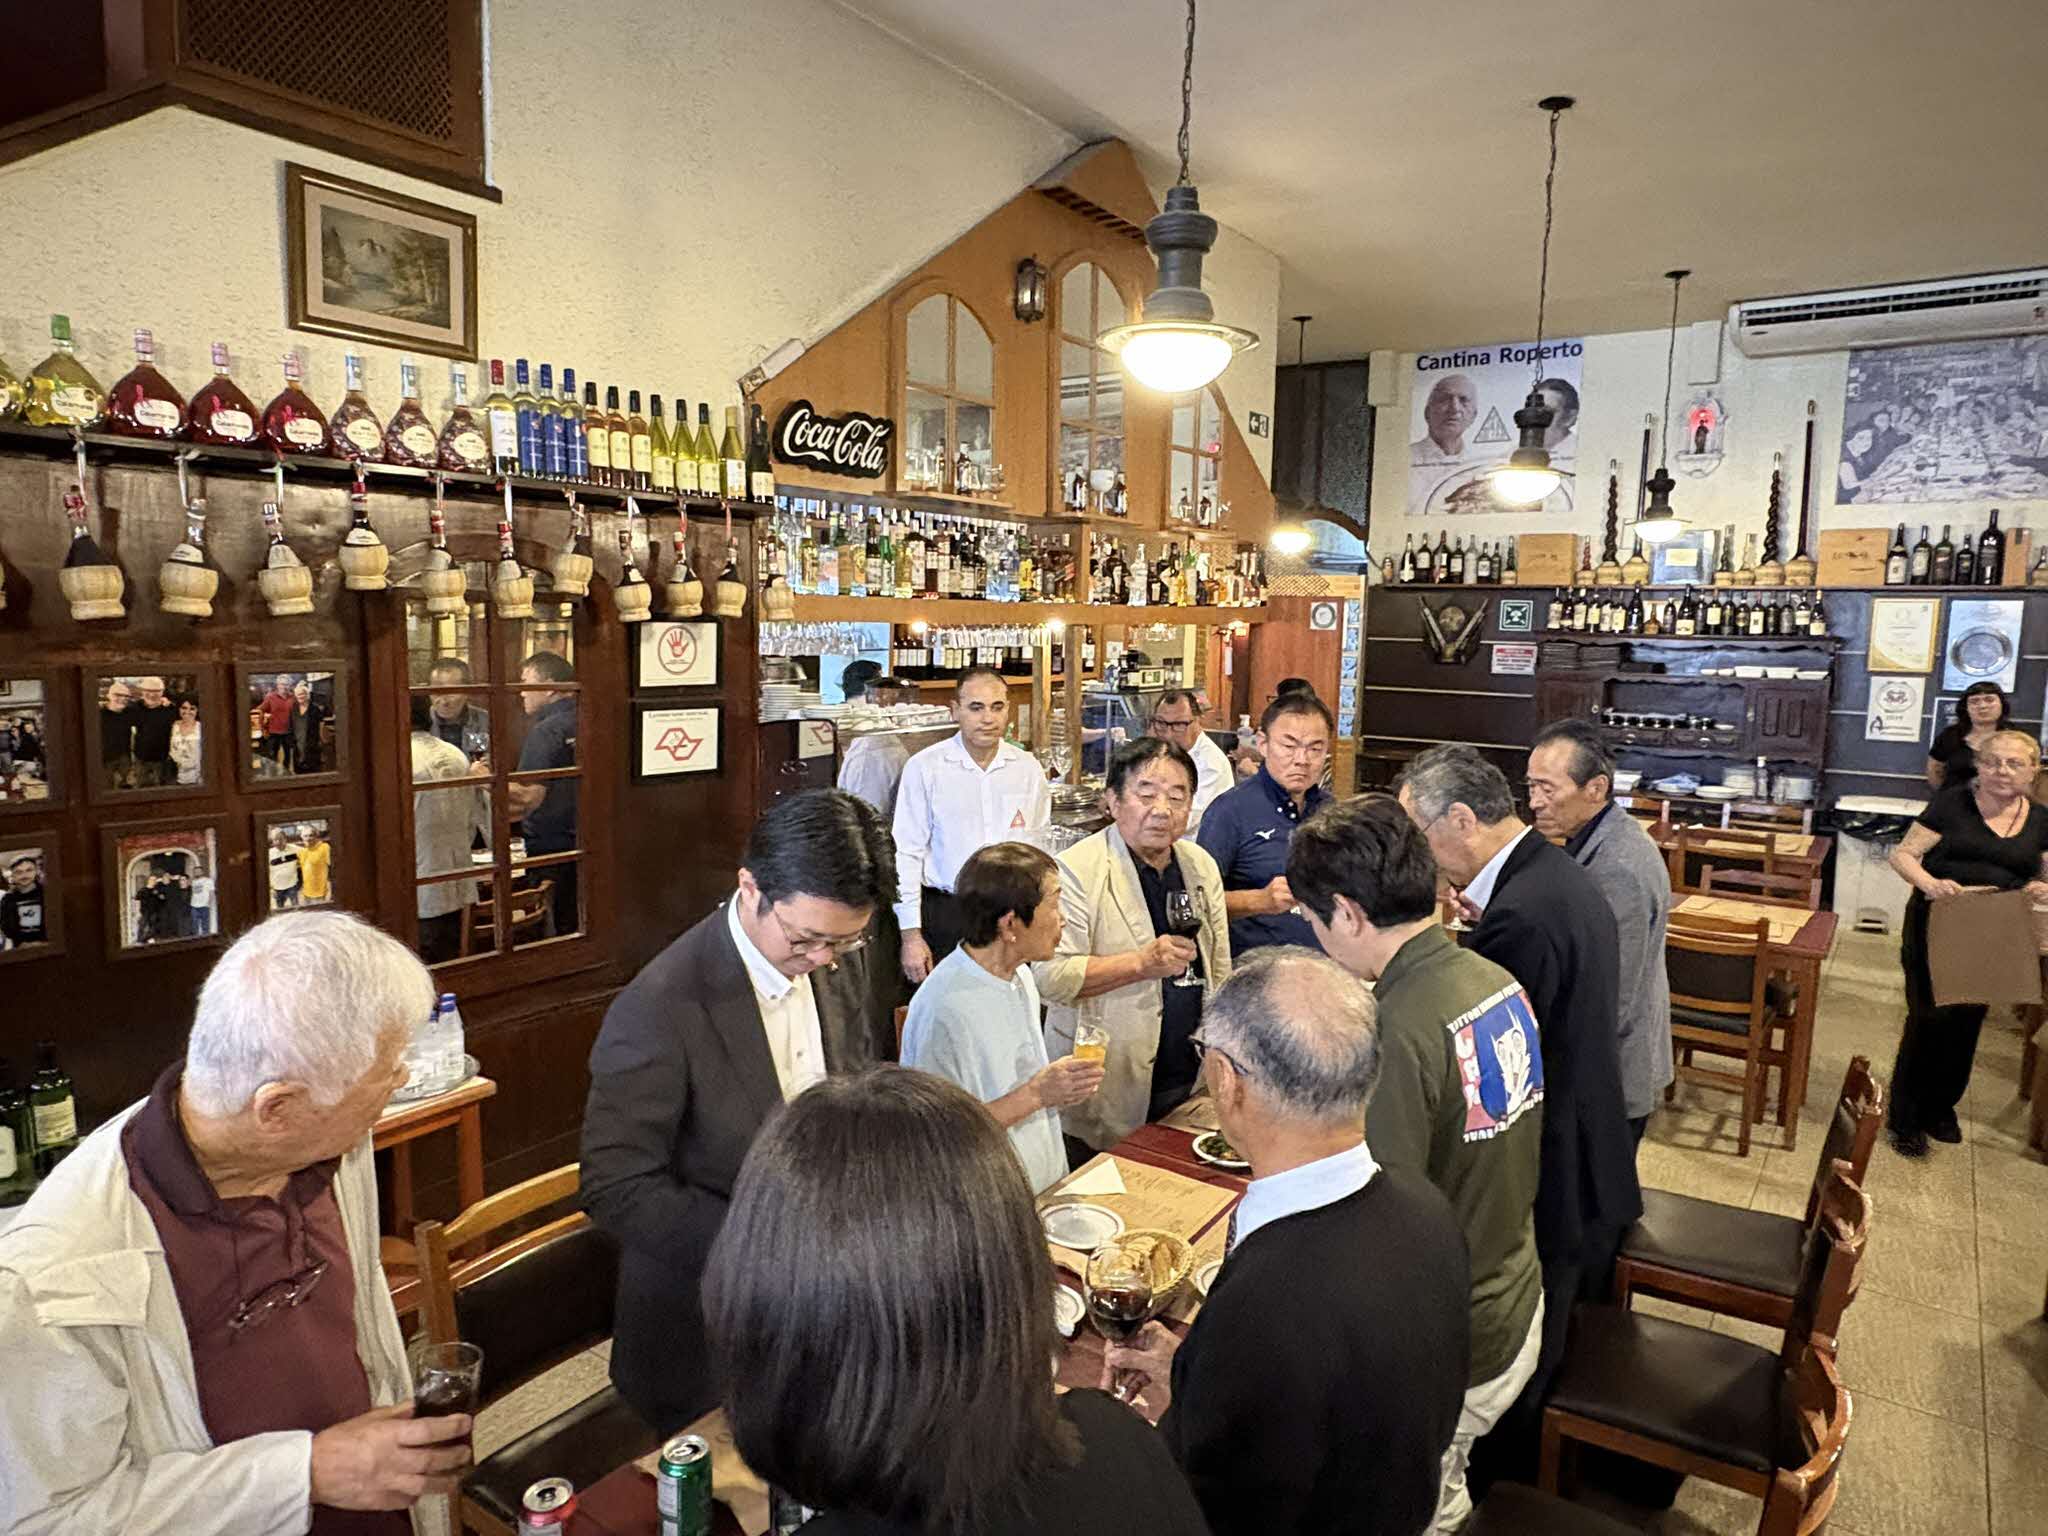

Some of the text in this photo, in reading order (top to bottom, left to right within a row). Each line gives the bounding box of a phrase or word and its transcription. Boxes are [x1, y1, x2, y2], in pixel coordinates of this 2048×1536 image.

[1416, 342, 1583, 371] Cantina Roperto
[783, 408, 889, 473] Coca-Cola
